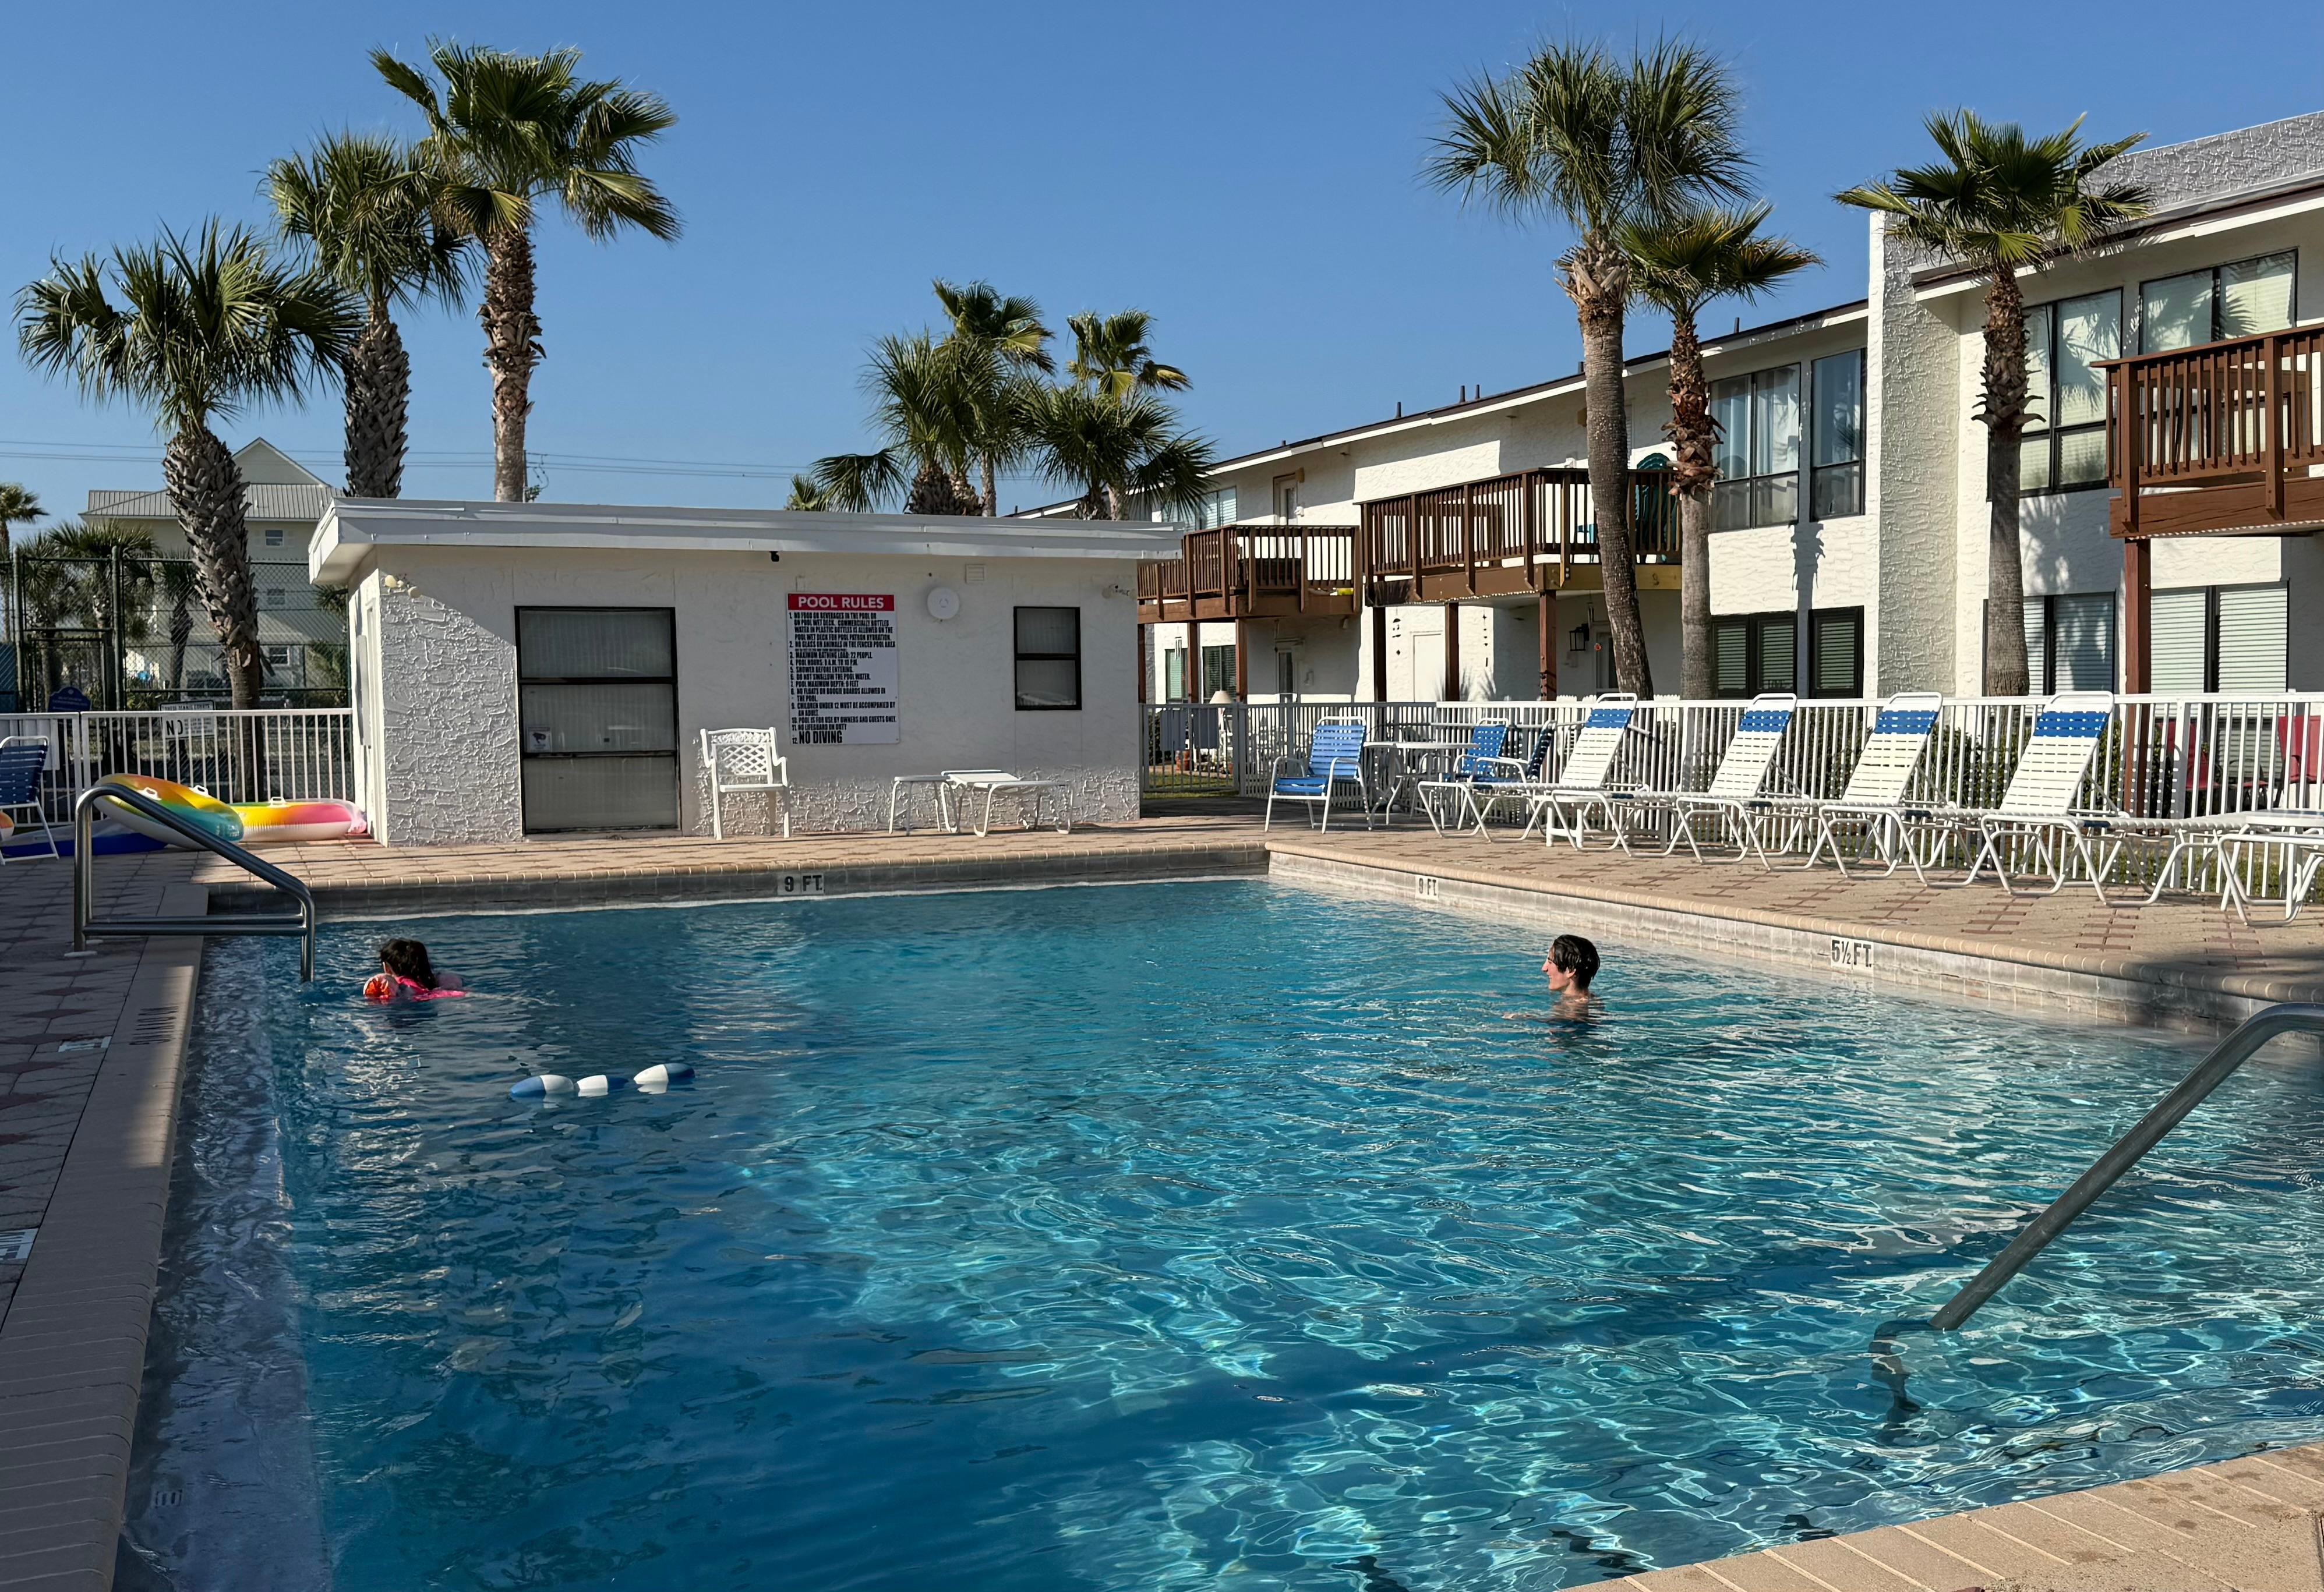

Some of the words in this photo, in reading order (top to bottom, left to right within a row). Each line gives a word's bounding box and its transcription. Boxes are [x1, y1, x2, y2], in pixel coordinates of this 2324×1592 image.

[798, 596, 838, 608] POOL
[842, 596, 884, 609] RULES
[166, 719, 183, 735] NO
[799, 730, 810, 744] NO
[813, 730, 842, 744] DIVING
[784, 876, 794, 892] 9
[803, 875, 822, 891] FT.
[1419, 878, 1424, 894] 9
[1832, 939, 1851, 964] 5½
[1853, 942, 1872, 968] FT.
